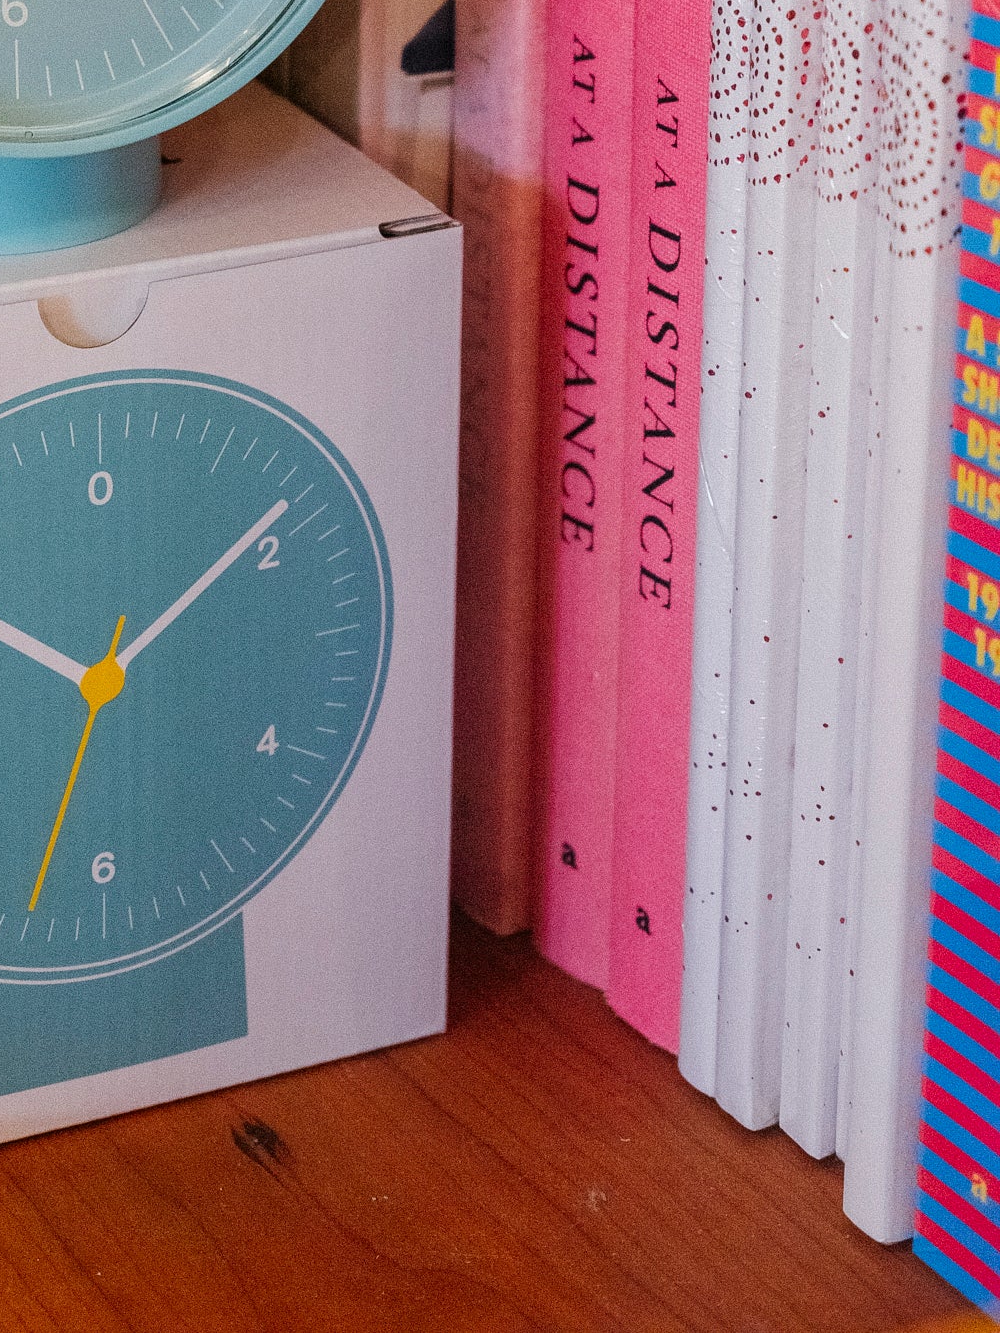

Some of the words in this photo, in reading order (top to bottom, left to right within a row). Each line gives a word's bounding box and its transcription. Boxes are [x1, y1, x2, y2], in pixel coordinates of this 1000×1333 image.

[572, 33, 596, 104] AT
[656, 74, 680, 149] AT
[571, 116, 595, 148] A
[654, 161, 677, 192] A
[966, 315, 986, 357] A
[560, 170, 600, 553] DISTANCE
[639, 216, 682, 610] DISTANCE
[87, 470, 114, 506] 0
[258, 534, 280, 570] 2
[256, 724, 279, 756] 4
[91, 851, 116, 884] 6
